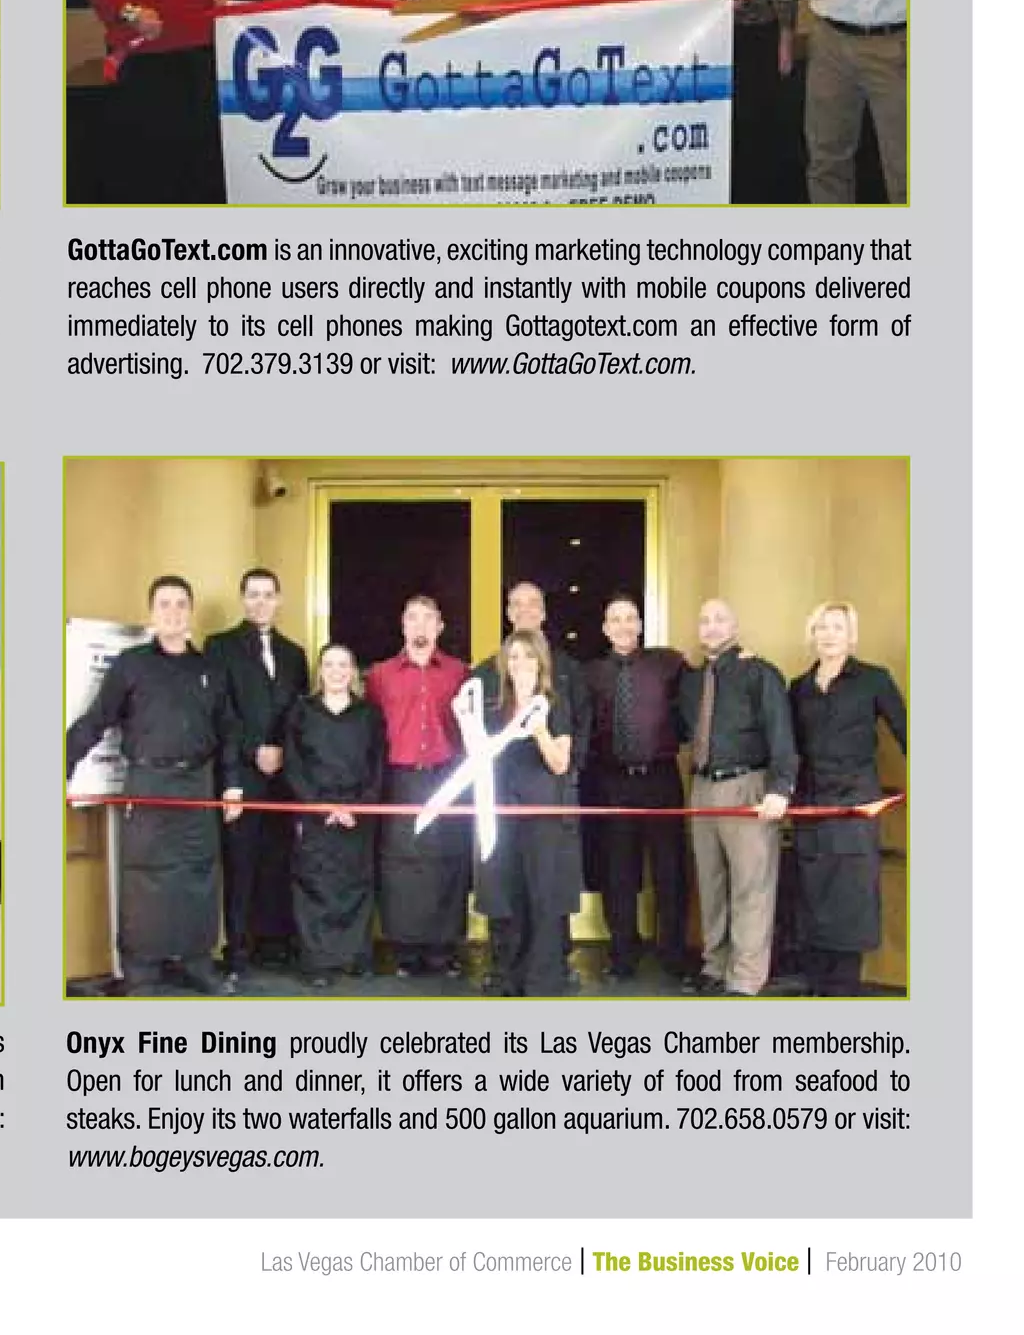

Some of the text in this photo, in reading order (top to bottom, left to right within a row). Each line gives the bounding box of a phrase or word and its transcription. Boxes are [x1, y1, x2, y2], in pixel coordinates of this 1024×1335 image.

[378, 45, 711, 113] GottaGoText
[378, 173, 432, 196] business
[487, 173, 538, 195] message
[540, 168, 598, 193] marketing
[68, 238, 911, 266] GottaGoText.com is an innovative, exciting marketing technology company that
[67, 1031, 909, 1058] Onyx Fine Dining proudly celebrated its Las Vegas Chamber membership.
[70, 1145, 323, 1172] www.bogeysvegas.com.
[262, 1252, 961, 1275] Las Vegas Chamber of Commerce The Business Voice February 2010
